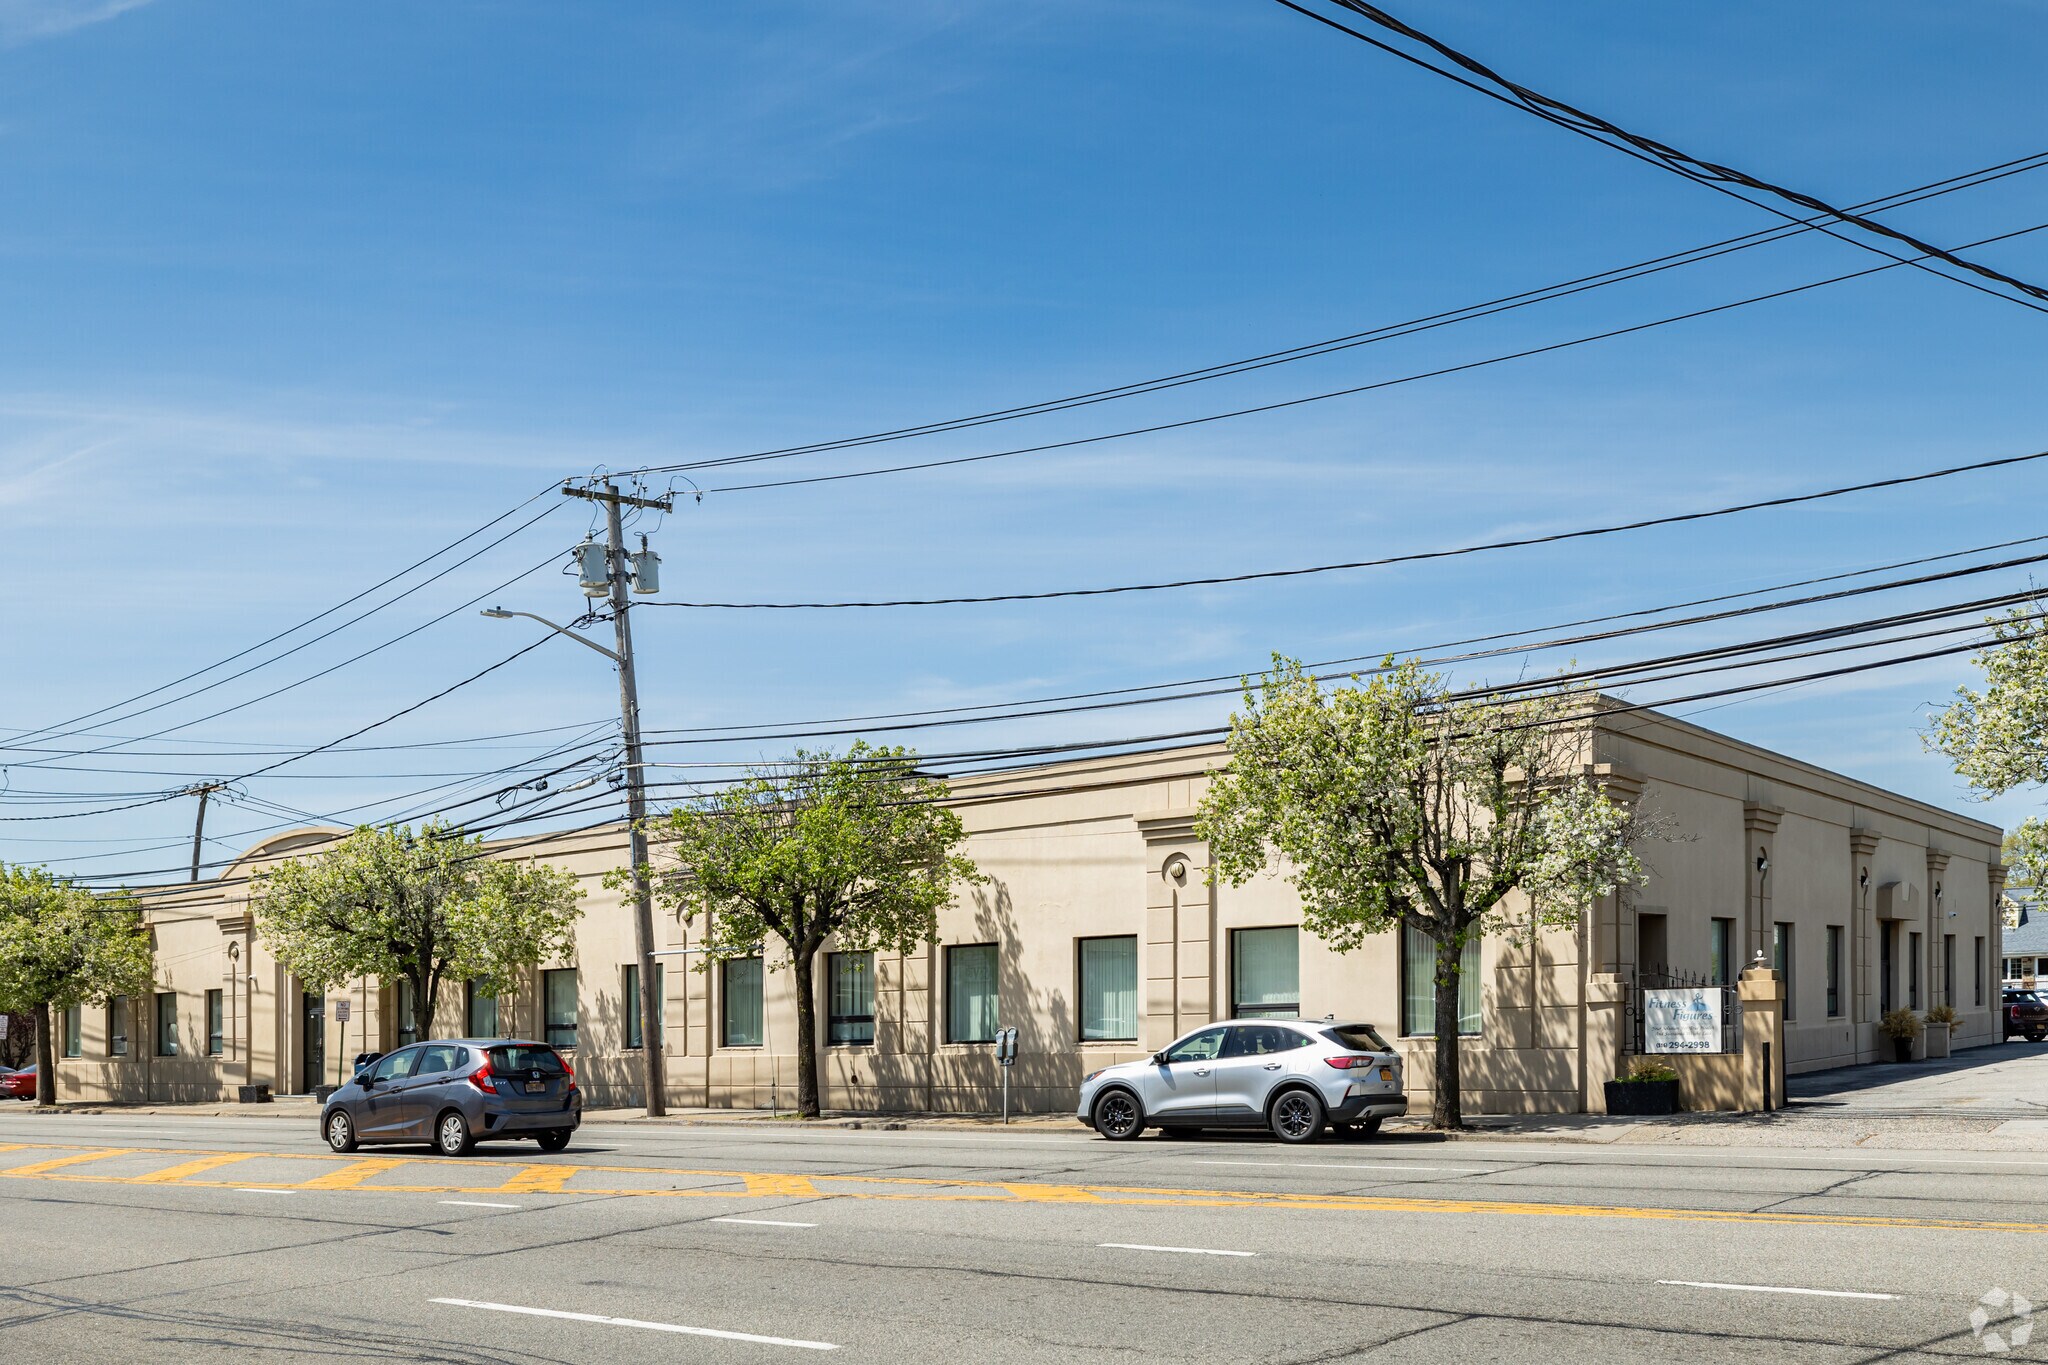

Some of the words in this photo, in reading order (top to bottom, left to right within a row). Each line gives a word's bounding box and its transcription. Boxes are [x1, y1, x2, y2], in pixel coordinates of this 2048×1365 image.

[1648, 996, 1687, 1009] Fitness
[1672, 1008, 1713, 1021] Figures
[1668, 1041, 1710, 1049] 294-2998
